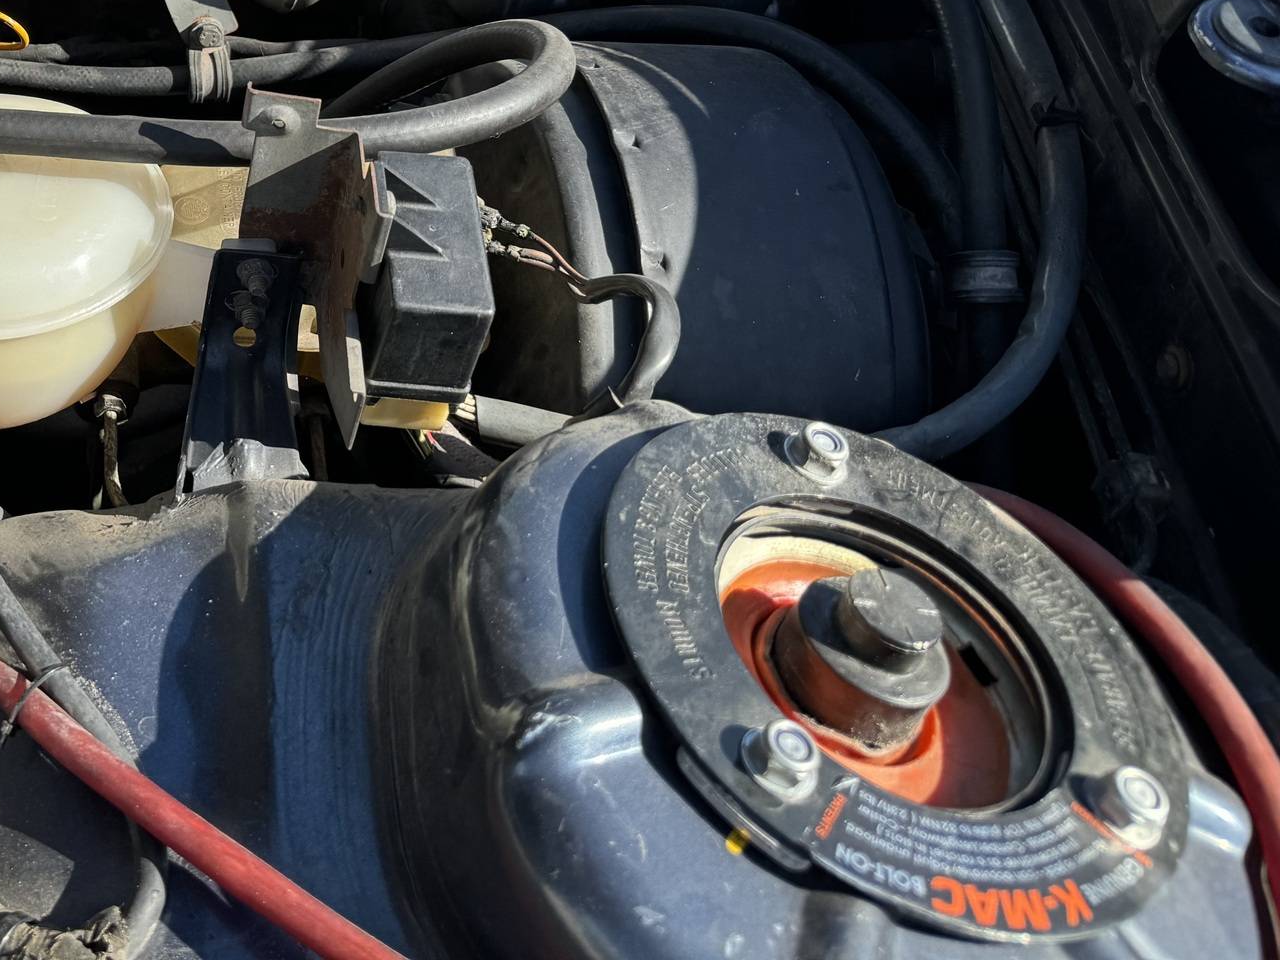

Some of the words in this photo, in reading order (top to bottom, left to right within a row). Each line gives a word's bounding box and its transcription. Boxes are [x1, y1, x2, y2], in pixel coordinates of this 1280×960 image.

[632, 533, 658, 592] TOWER
[833, 841, 927, 900] BOLT-ON
[930, 876, 1094, 930] K-MAC
